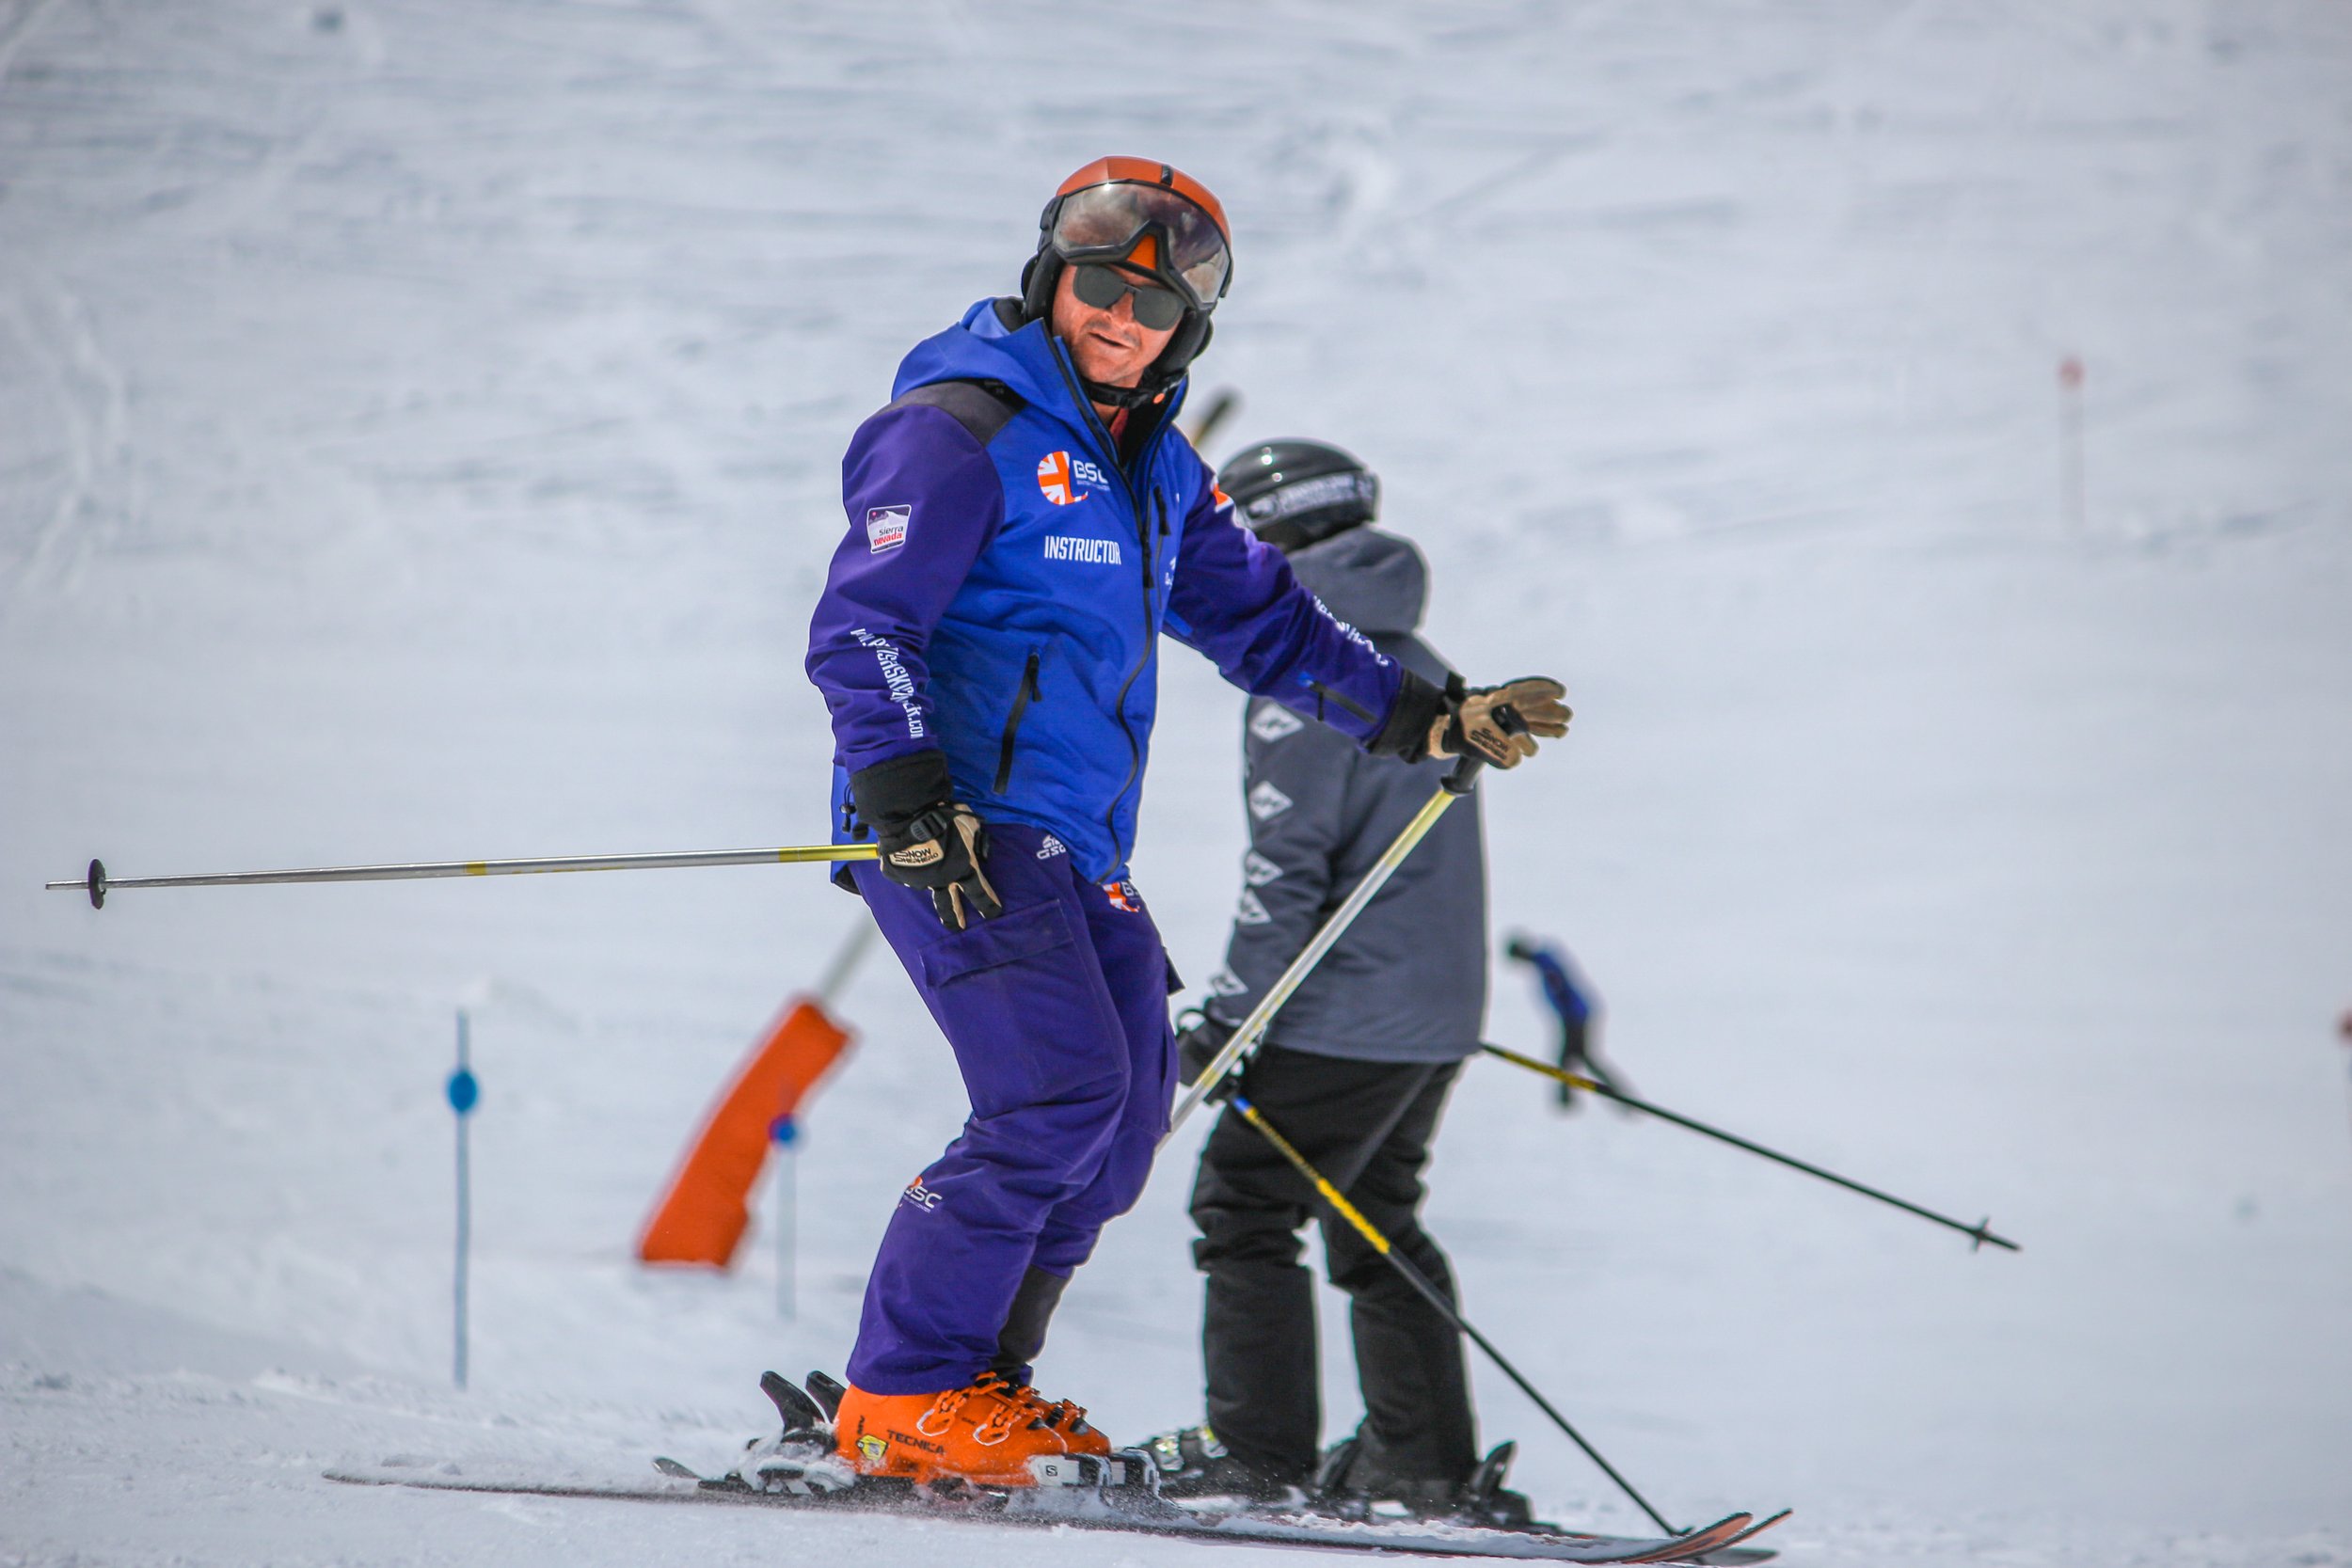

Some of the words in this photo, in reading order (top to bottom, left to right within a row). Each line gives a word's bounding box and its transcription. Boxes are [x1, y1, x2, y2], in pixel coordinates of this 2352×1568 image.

[879, 526, 903, 536] sierra
[873, 533, 902, 546] nevada
[1044, 535, 1121, 565] INSTRUCTOR
[893, 847, 931, 859] SNOW
[886, 1429, 946, 1454] TECNICA
